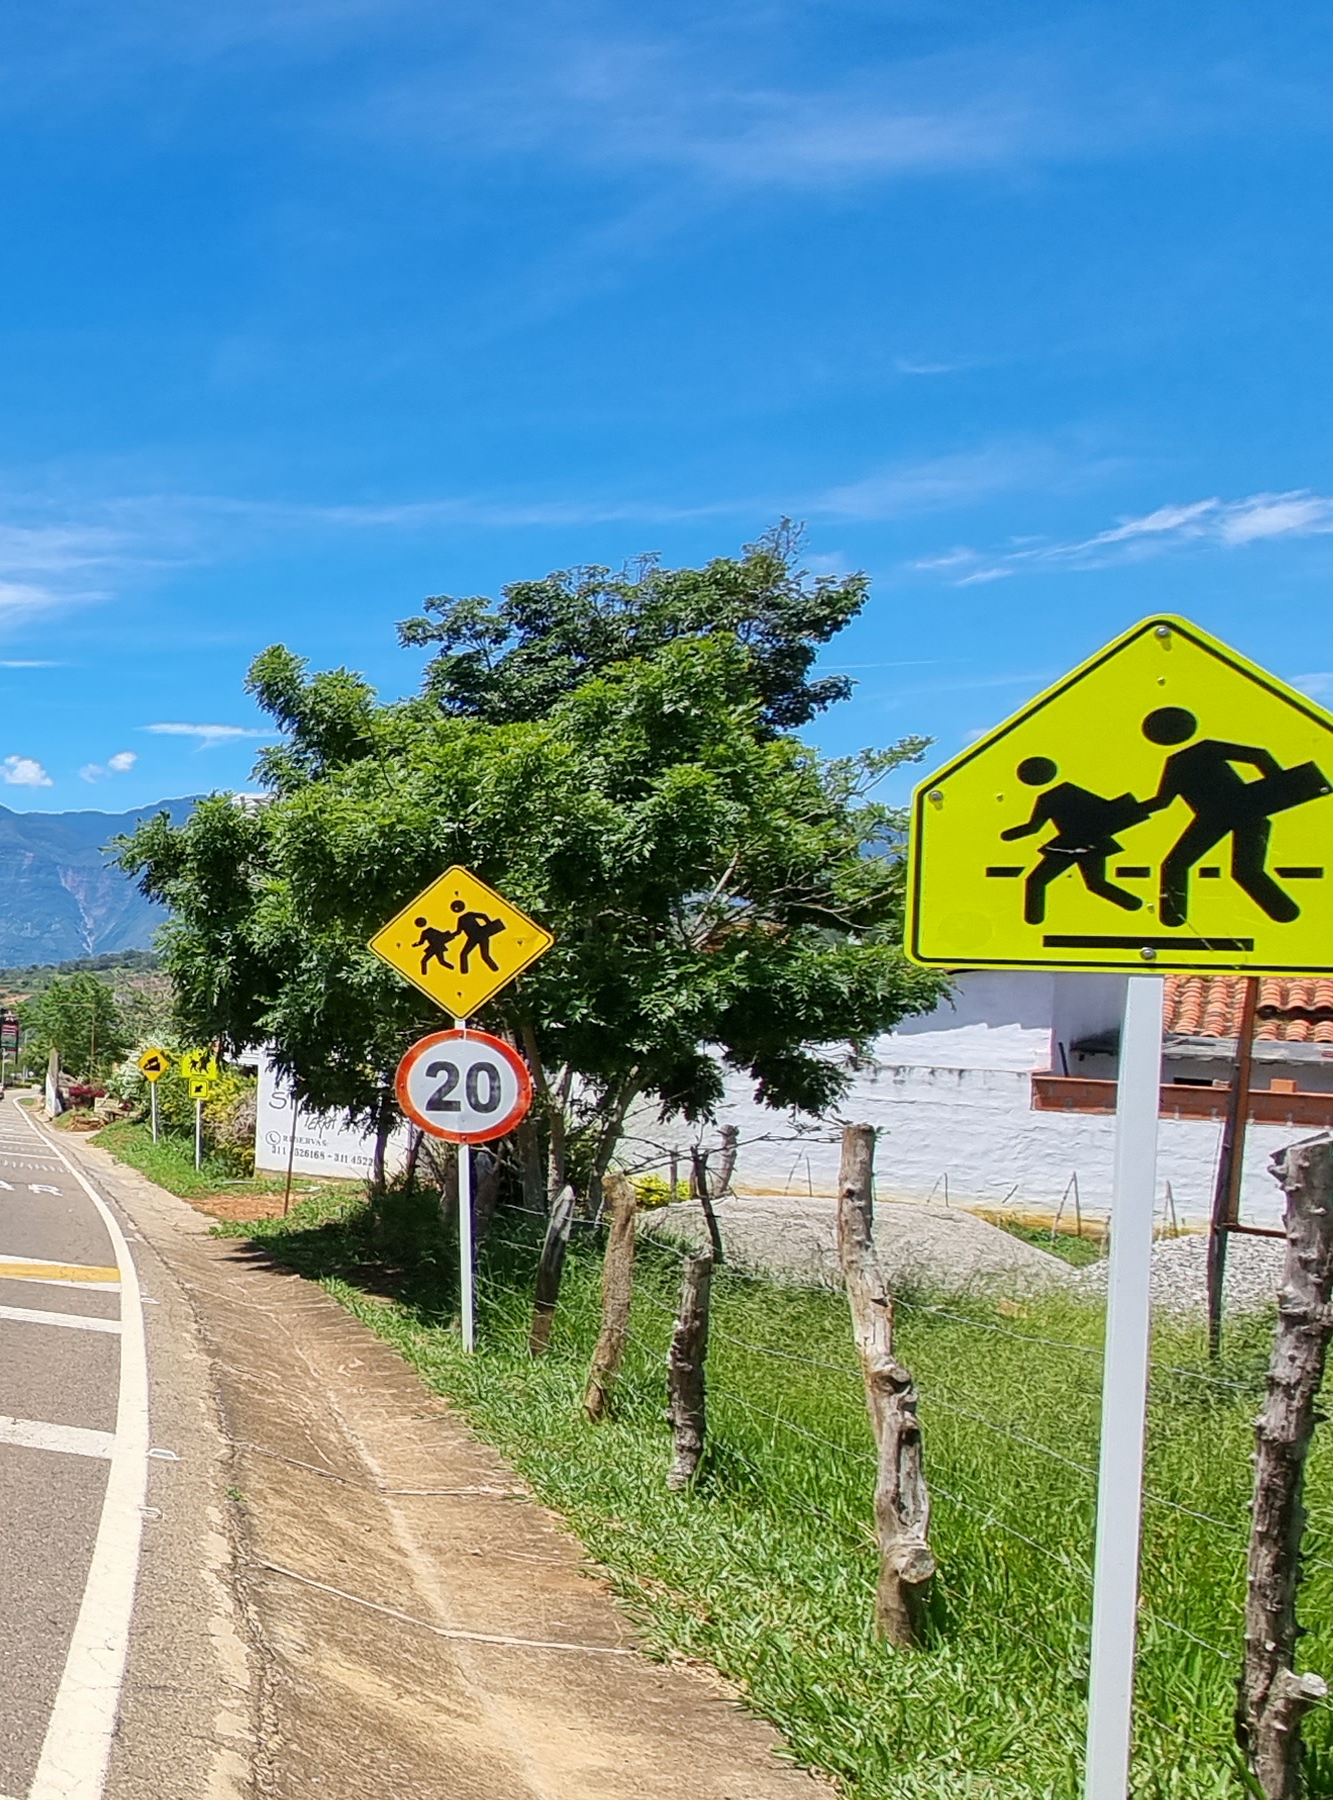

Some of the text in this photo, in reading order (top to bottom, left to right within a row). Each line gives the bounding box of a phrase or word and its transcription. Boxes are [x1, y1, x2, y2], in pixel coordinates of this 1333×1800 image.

[425, 1060, 501, 1114] 20
[271, 1145, 286, 1155] 311
[290, 1147, 325, 1160] 526168
[334, 1153, 348, 1164] 311
